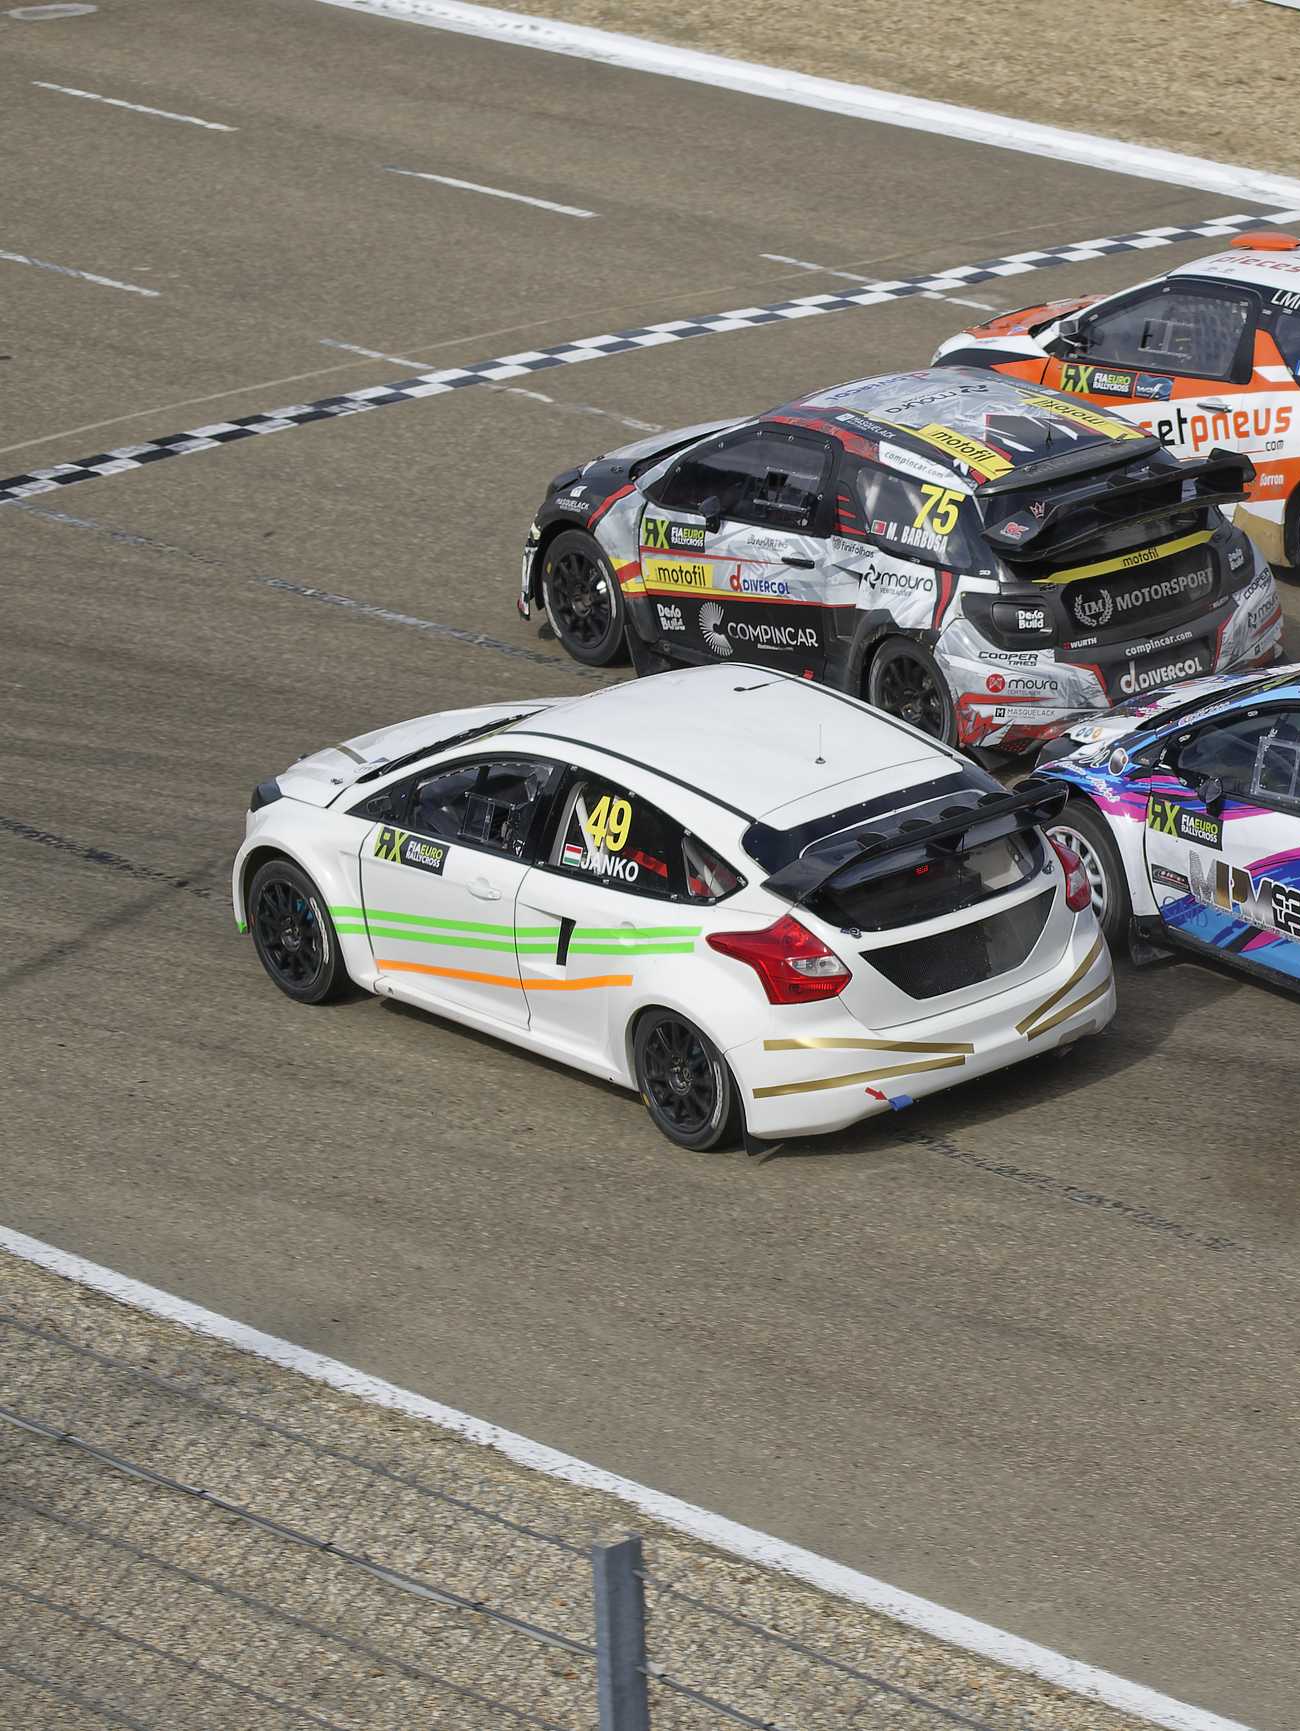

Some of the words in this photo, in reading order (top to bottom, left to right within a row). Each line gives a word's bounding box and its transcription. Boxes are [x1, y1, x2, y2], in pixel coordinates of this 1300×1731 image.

[931, 430, 996, 463] motofil
[913, 483, 966, 536] 75
[901, 525, 949, 552] BARBOSA
[657, 565, 706, 587] motofil
[880, 572, 934, 593] moura
[1116, 567, 1214, 612] MOTORSPORT
[727, 622, 819, 648] COMPINCAR
[1125, 631, 1193, 657] compincar.com
[978, 651, 1039, 661] COOPER
[1008, 679, 1058, 690] moura
[1139, 657, 1203, 690] DIVERCOL
[585, 795, 632, 852] 49
[1181, 824, 1218, 843] RALLYCROSS
[406, 850, 441, 868] RALLYCROSS
[581, 851, 639, 882] JANKO
